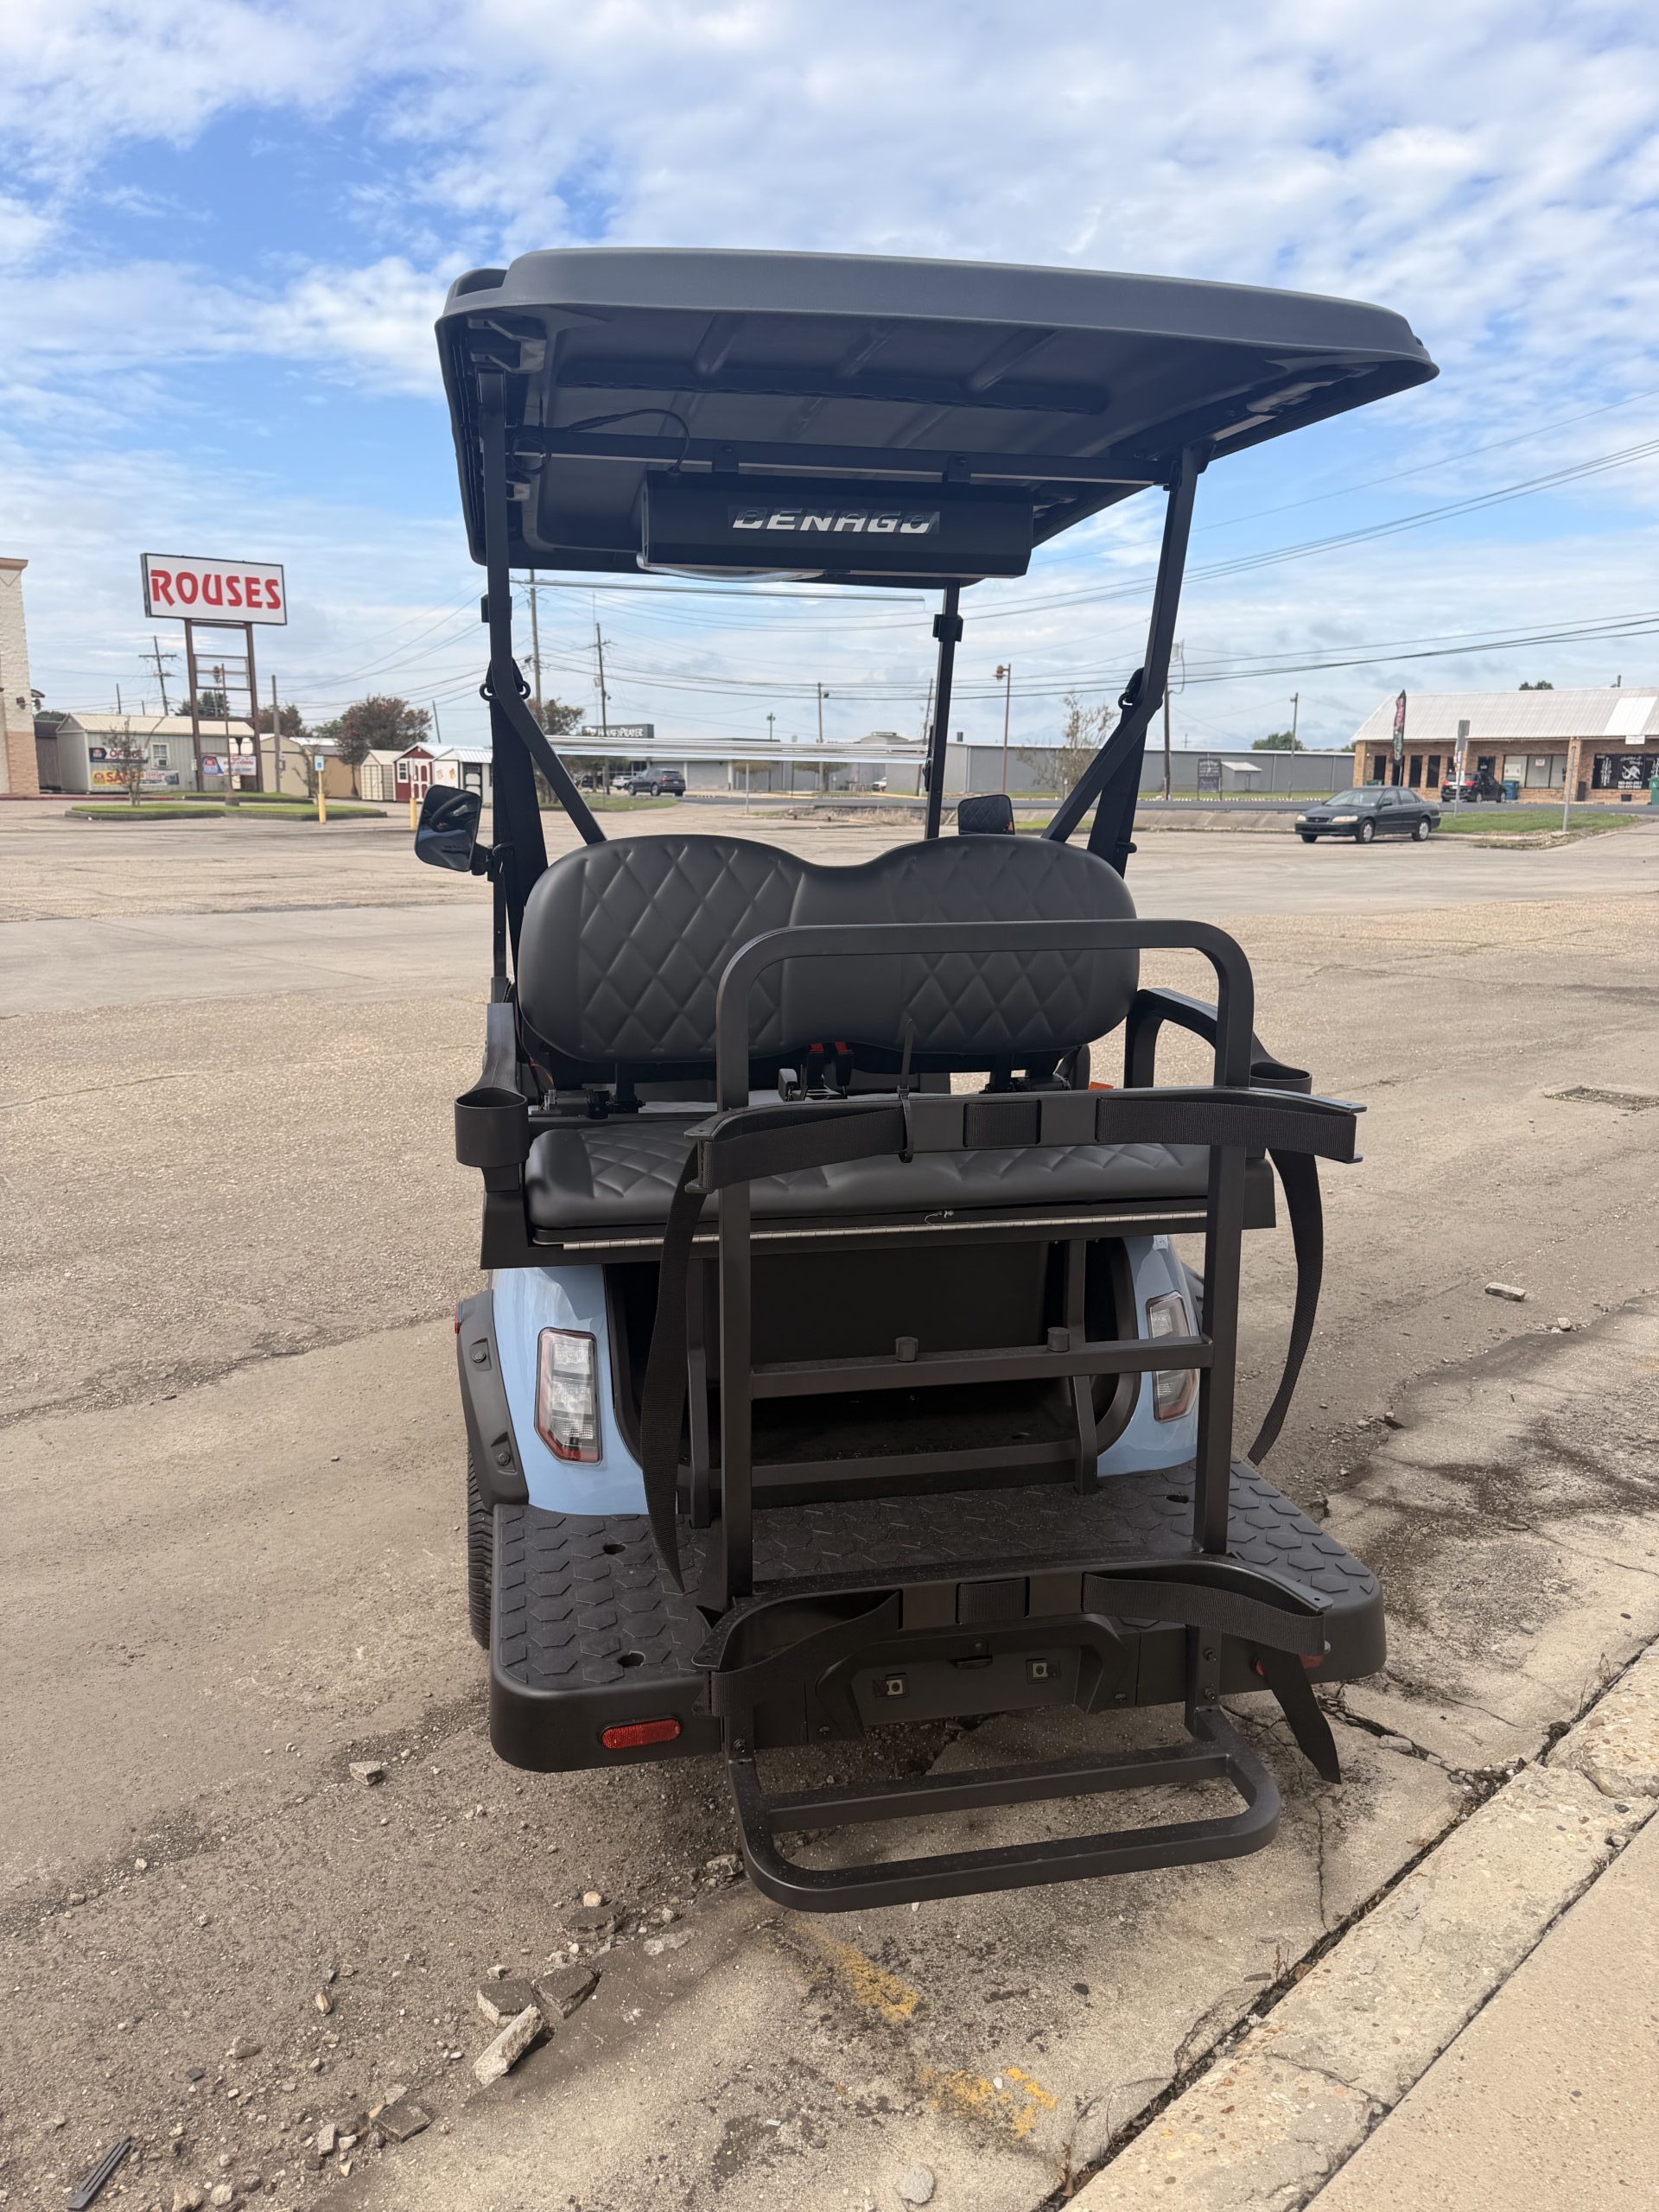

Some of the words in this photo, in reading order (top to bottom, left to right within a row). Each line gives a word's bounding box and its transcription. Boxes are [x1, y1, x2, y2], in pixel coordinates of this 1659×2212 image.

[732, 509, 938, 534] DENAGO
[150, 569, 281, 609] ROUSES
[110, 749, 143, 759] OFCE
